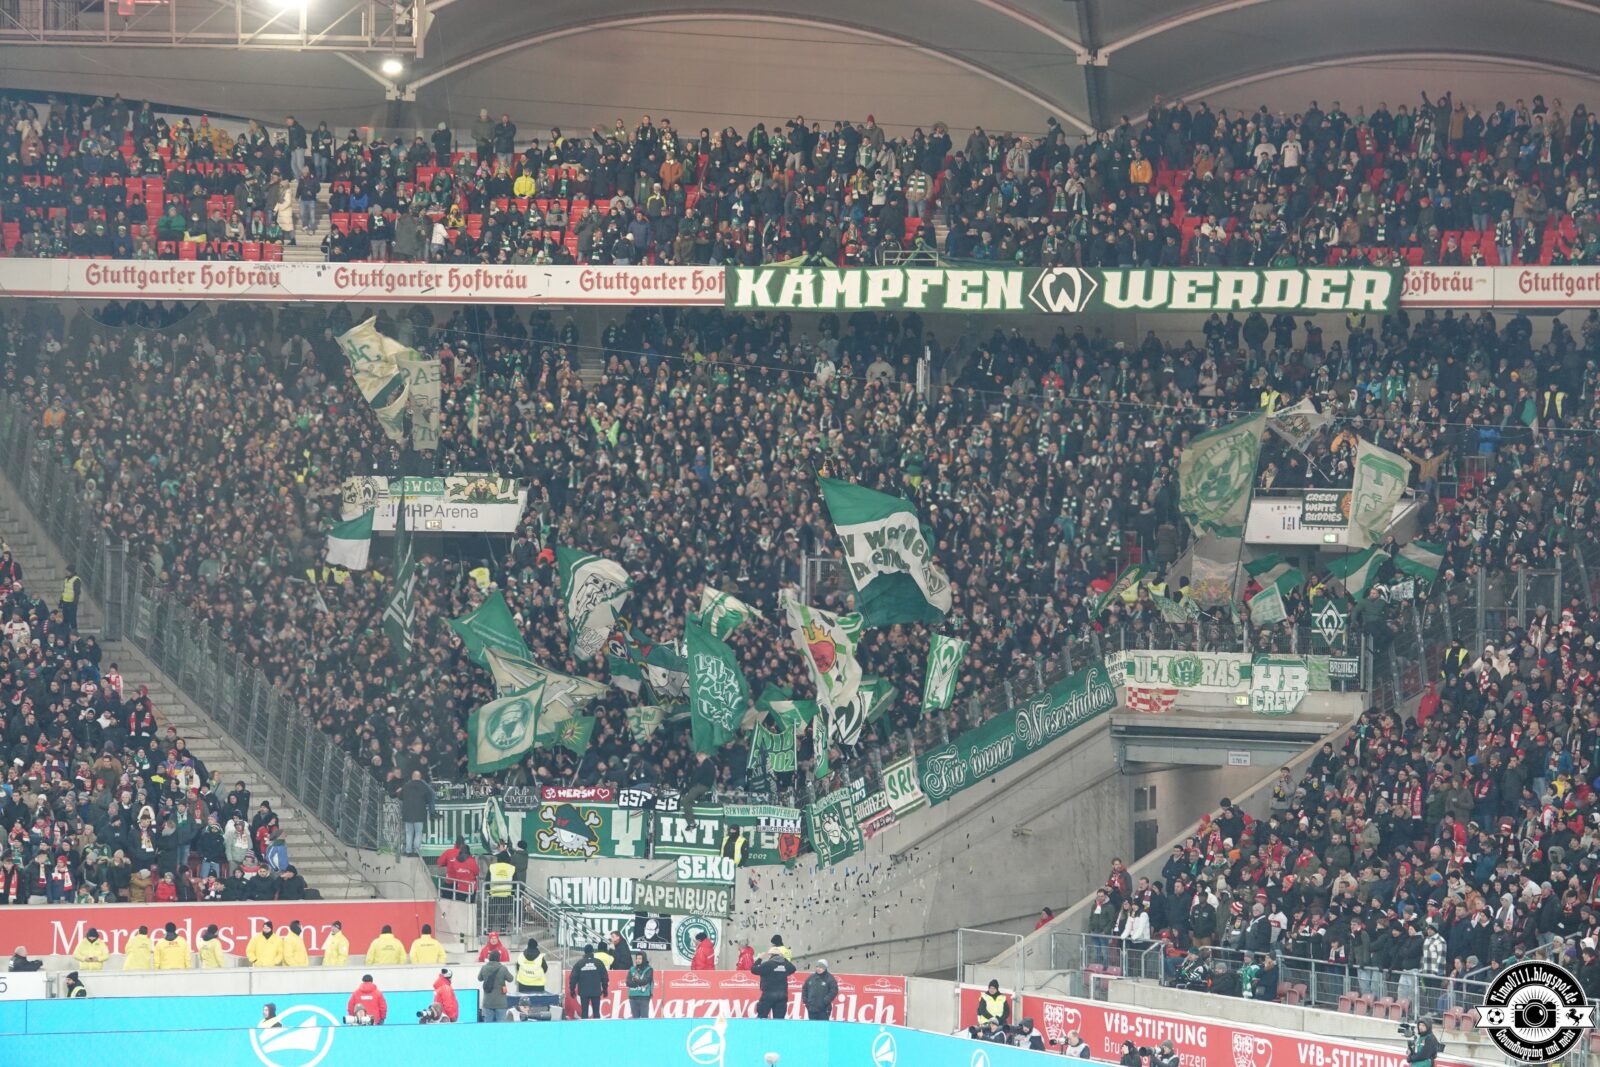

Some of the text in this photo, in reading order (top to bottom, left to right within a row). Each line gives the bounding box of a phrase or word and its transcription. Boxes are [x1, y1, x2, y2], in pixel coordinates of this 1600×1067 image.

[86, 263, 281, 290] Stuttgarter Hofbräu
[334, 266, 528, 293] Stuttgarter Hofbräu
[579, 269, 687, 295] Stuttgarter
[734, 268, 1024, 310] KÄMPFEN
[1101, 269, 1392, 310] WERDER
[1305, 494, 1339, 502] GREEN
[1305, 503, 1337, 511] WHITE
[434, 505, 479, 519] Arena
[1305, 513, 1342, 522] BUDDIES
[1329, 660, 1358, 674] BREMEN
[1252, 690, 1305, 712] CREW
[923, 744, 968, 798] Für
[970, 732, 1015, 778] immer
[1016, 667, 1114, 750] Weserstadion
[558, 788, 596, 800] HERSH
[887, 766, 915, 800] SRL
[660, 816, 719, 845] INT
[677, 856, 735, 881] SEKO
[550, 877, 633, 905] DETMOLD
[634, 883, 728, 913] PAPENBURG
[51, 917, 337, 955] Mreds-Bnz
[1103, 1012, 1207, 1047] VfB-STIFTUNG
